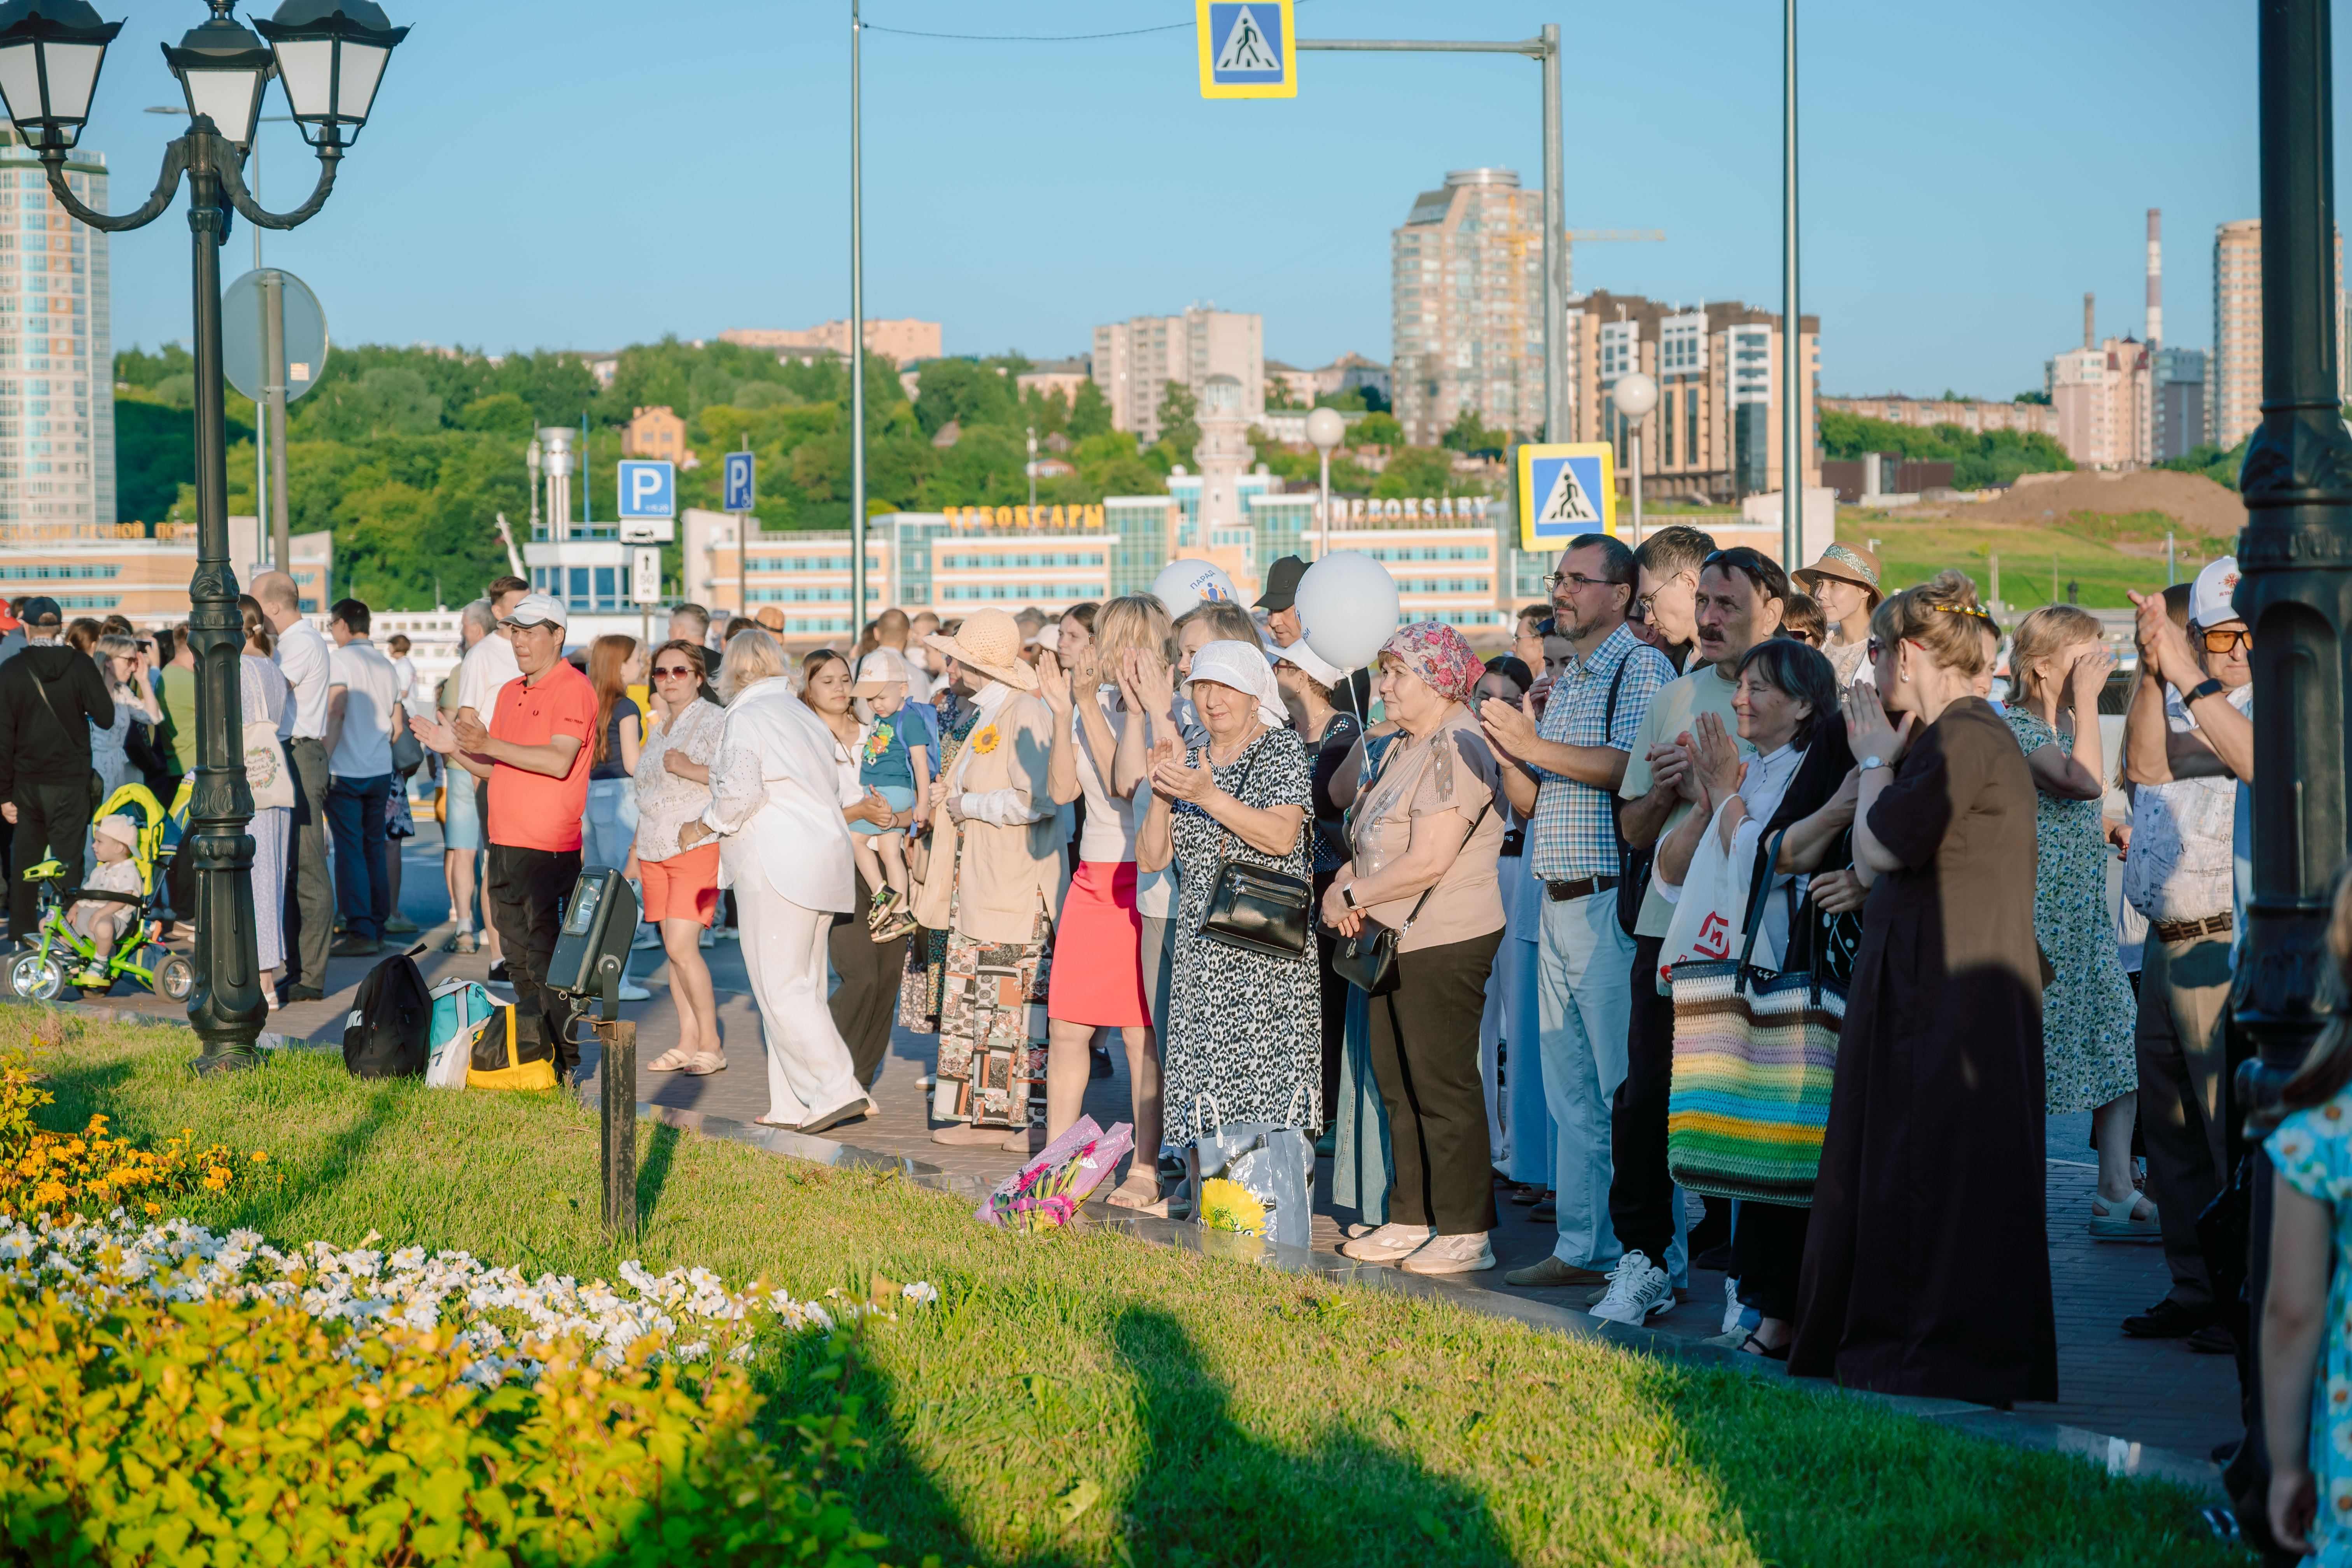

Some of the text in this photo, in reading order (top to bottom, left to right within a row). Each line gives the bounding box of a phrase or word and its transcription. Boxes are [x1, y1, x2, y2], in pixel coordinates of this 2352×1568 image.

[632, 468, 663, 511] P
[730, 460, 748, 505] P
[943, 504, 1105, 530] ЧЕБОКСАРЫ
[639, 572, 655, 586] 50
[1190, 570, 1216, 590] ПАРАД
[60, 919, 81, 943] FORMULA
